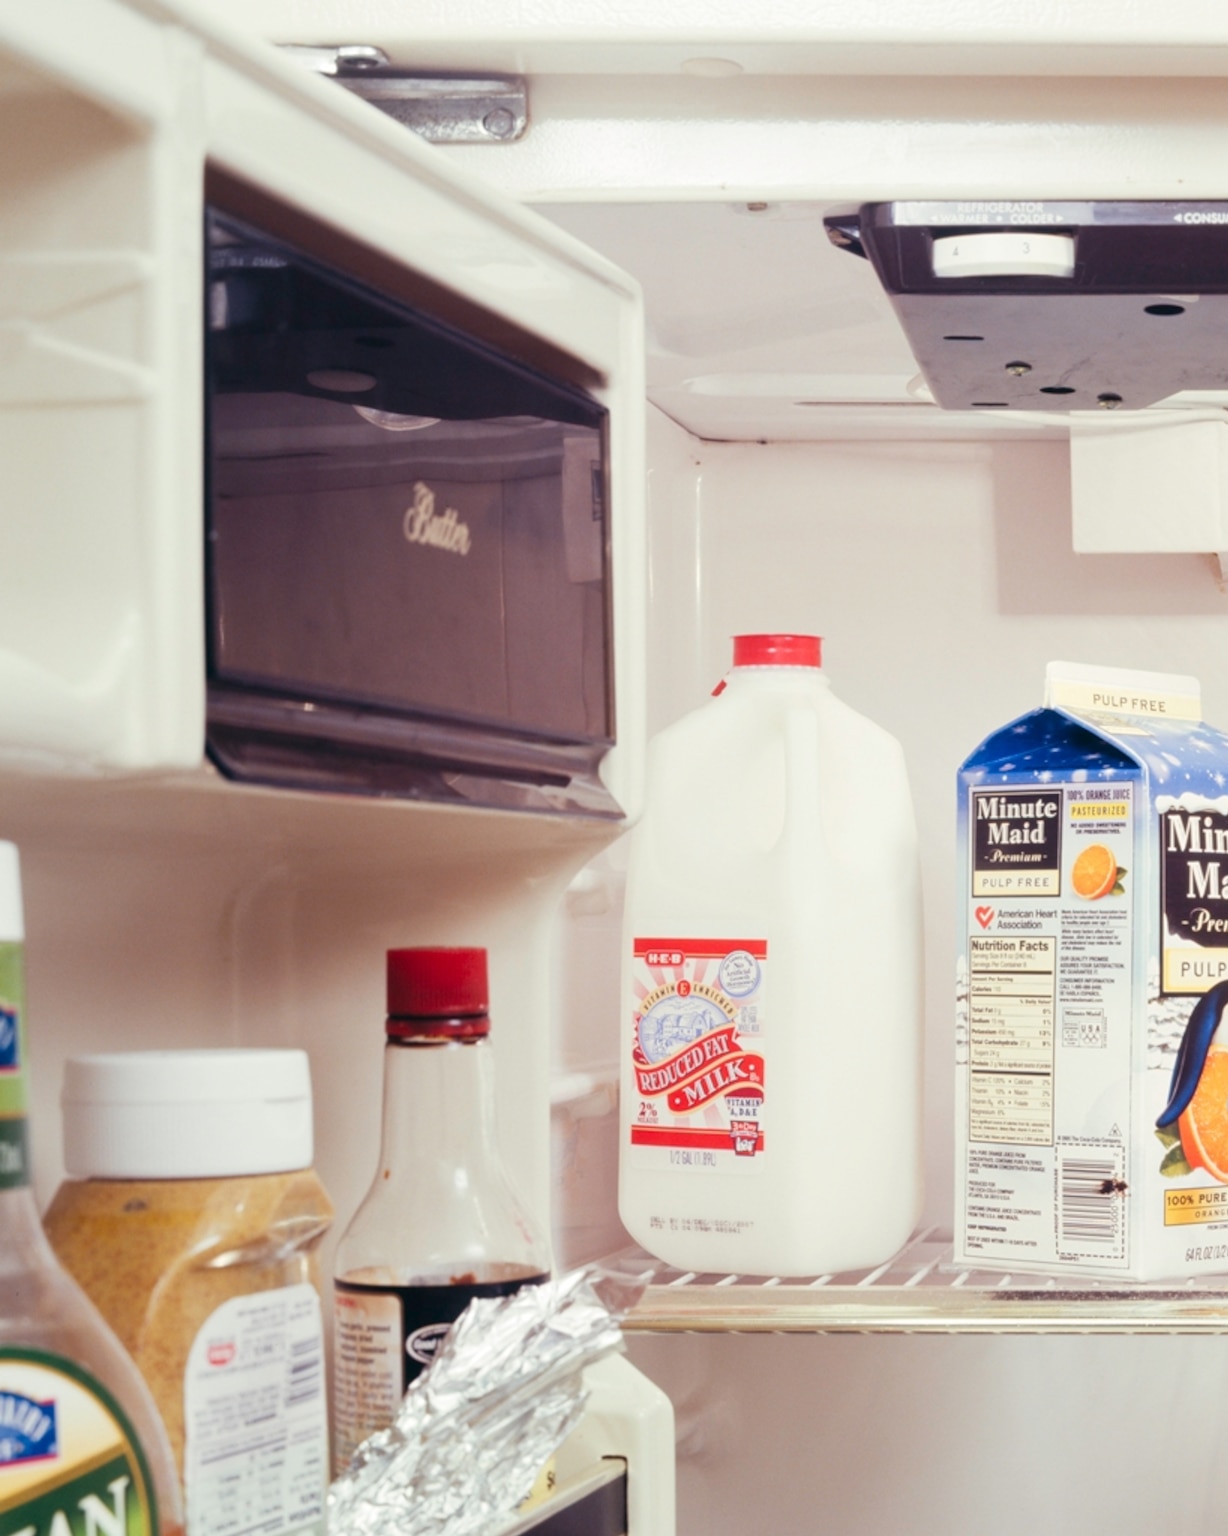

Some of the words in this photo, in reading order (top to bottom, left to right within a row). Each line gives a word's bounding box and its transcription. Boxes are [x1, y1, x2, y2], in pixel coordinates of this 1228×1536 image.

[957, 202, 1044, 213] REFRIGERATOR
[939, 213, 989, 224] WARMER
[1009, 213, 1054, 224] COLDER
[1022, 242, 1031, 255] 3
[403, 481, 472, 555] Butter
[1092, 693, 1128, 708] PULP
[1131, 698, 1167, 713] FREE
[1067, 789, 1084, 801] 100%
[1086, 788, 1111, 801] ORANGE
[1113, 788, 1131, 800] JUICE
[976, 797, 1058, 820] Minute
[1071, 806, 1126, 817] PASTEURIZED
[987, 820, 1046, 845] Maid
[982, 878, 1014, 888] PULP
[1017, 877, 1050, 888] FREE
[997, 909, 1033, 918] American
[1036, 909, 1057, 918] Heart
[997, 920, 1042, 930] Association
[971, 940, 1016, 951] Nutrition
[1019, 940, 1049, 951] Facts
[1181, 961, 1228, 978] PULP
[643, 984, 675, 1012] VITAMIN
[679, 982, 688, 996] E
[693, 985, 734, 1015] ENRICHED
[639, 1047, 704, 1091] REDUCED
[703, 1035, 730, 1062] FAT
[682, 1058, 749, 1107] MILK
[638, 1102, 658, 1117] 2%
[726, 1097, 761, 1107] VITAMIN
[1167, 1194, 1195, 1207] 100%
[1198, 1192, 1228, 1205] PURE
[1185, 1248, 1195, 1262] 64
[1202, 1246, 1213, 1260] OZ
